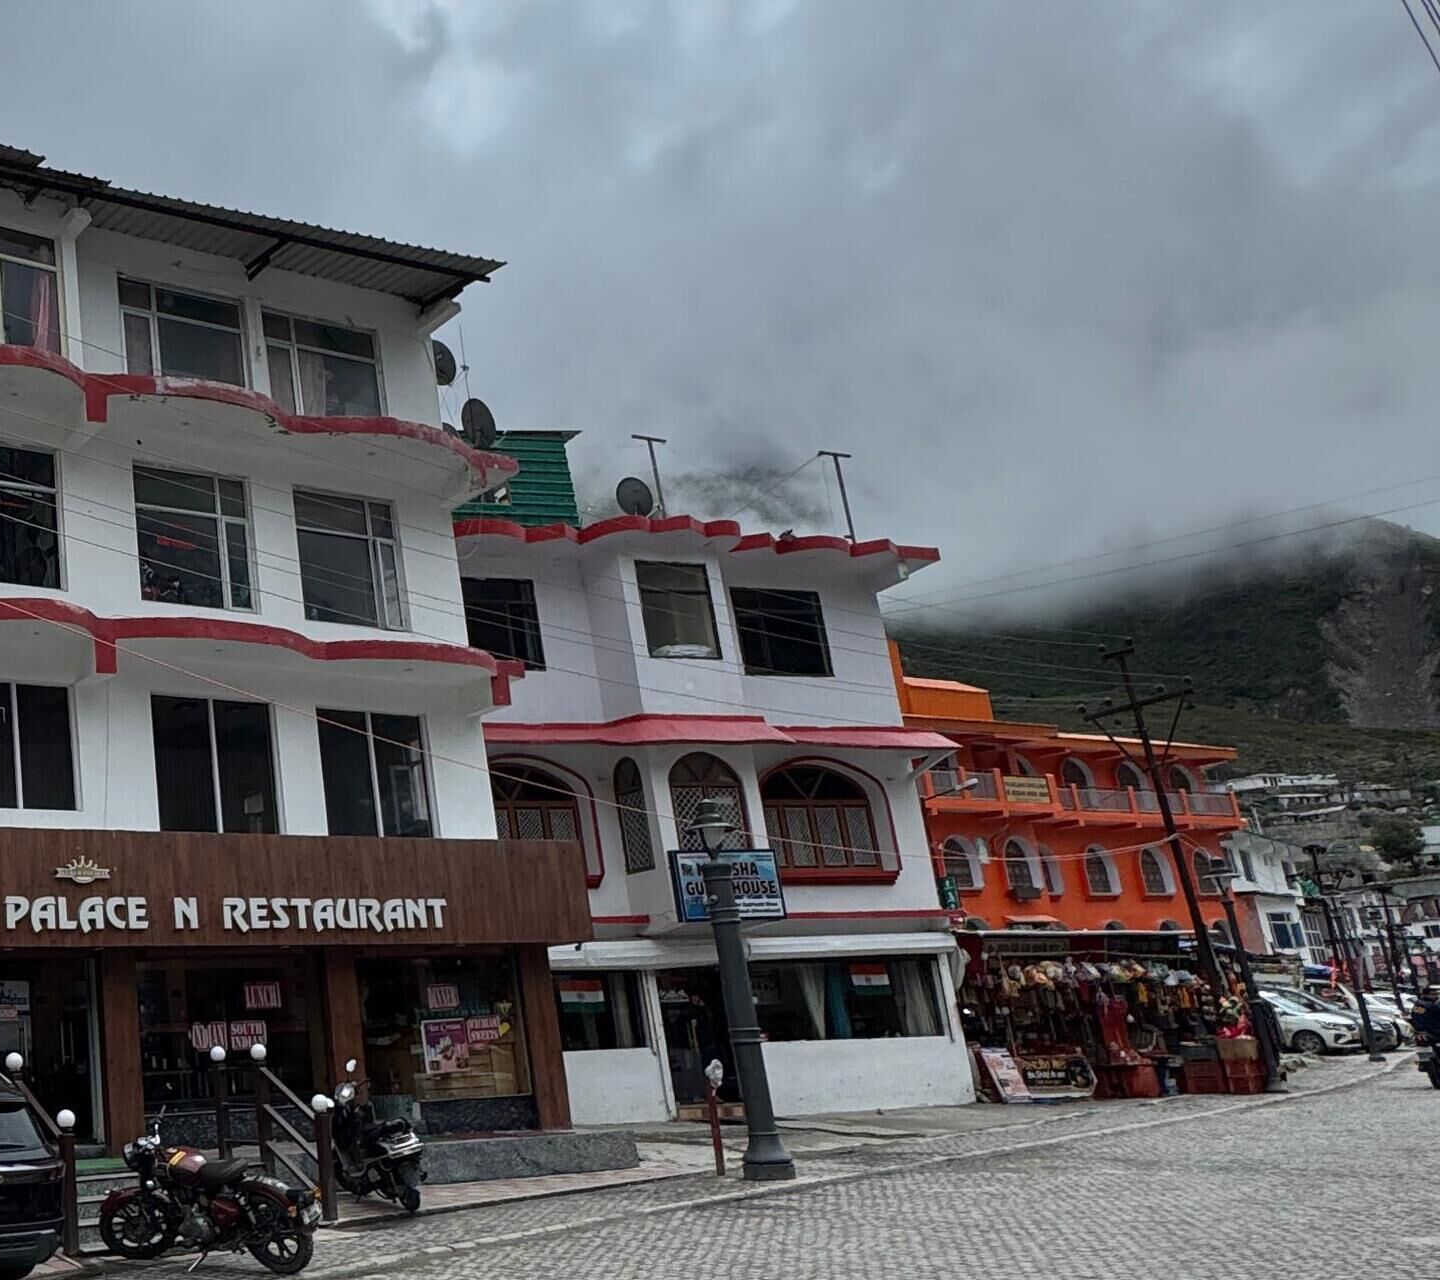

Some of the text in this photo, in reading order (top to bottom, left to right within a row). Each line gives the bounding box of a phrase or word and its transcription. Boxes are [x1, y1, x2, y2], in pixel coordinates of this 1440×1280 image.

[731, 880, 777, 894] HOUSE
[4, 895, 149, 933] PALACE
[173, 896, 199, 930] N
[222, 897, 447, 933] RESTAURANT
[245, 984, 281, 1009] LUNCH
[230, 1023, 263, 1035] SOUTH
